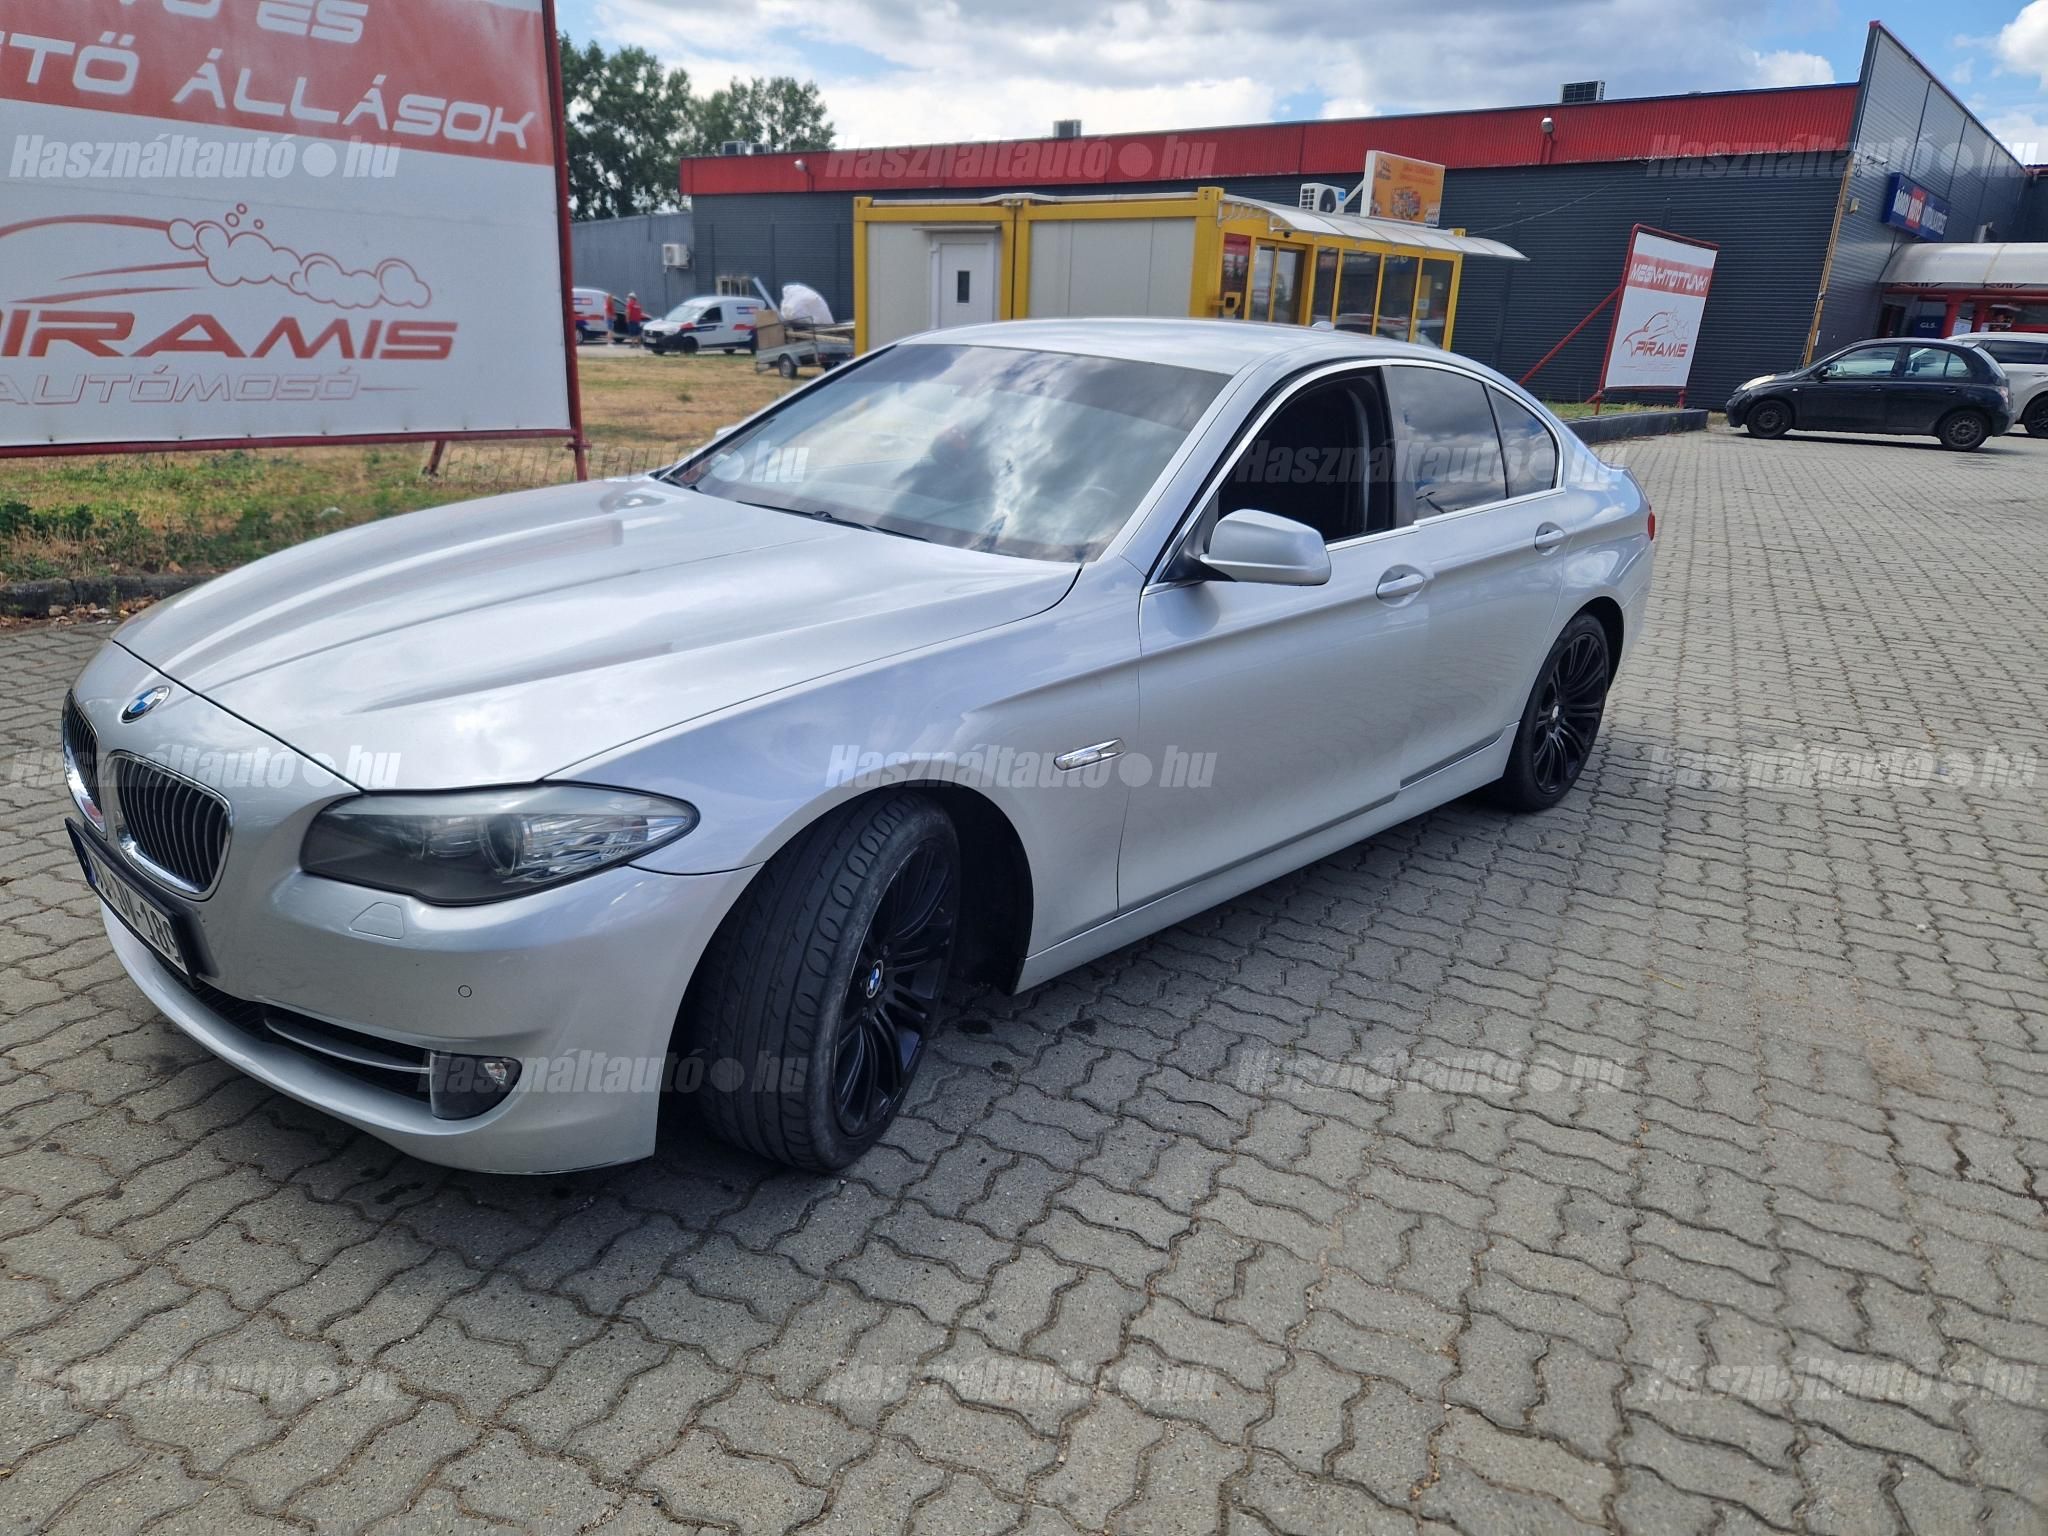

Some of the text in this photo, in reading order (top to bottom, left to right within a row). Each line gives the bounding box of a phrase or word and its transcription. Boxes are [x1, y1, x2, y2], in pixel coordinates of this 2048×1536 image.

[0, 31, 536, 150] TŐ ÁLLÁSOK
[0, 308, 459, 361] IRAMIS
[1631, 339, 1689, 358] PIRAMIS
